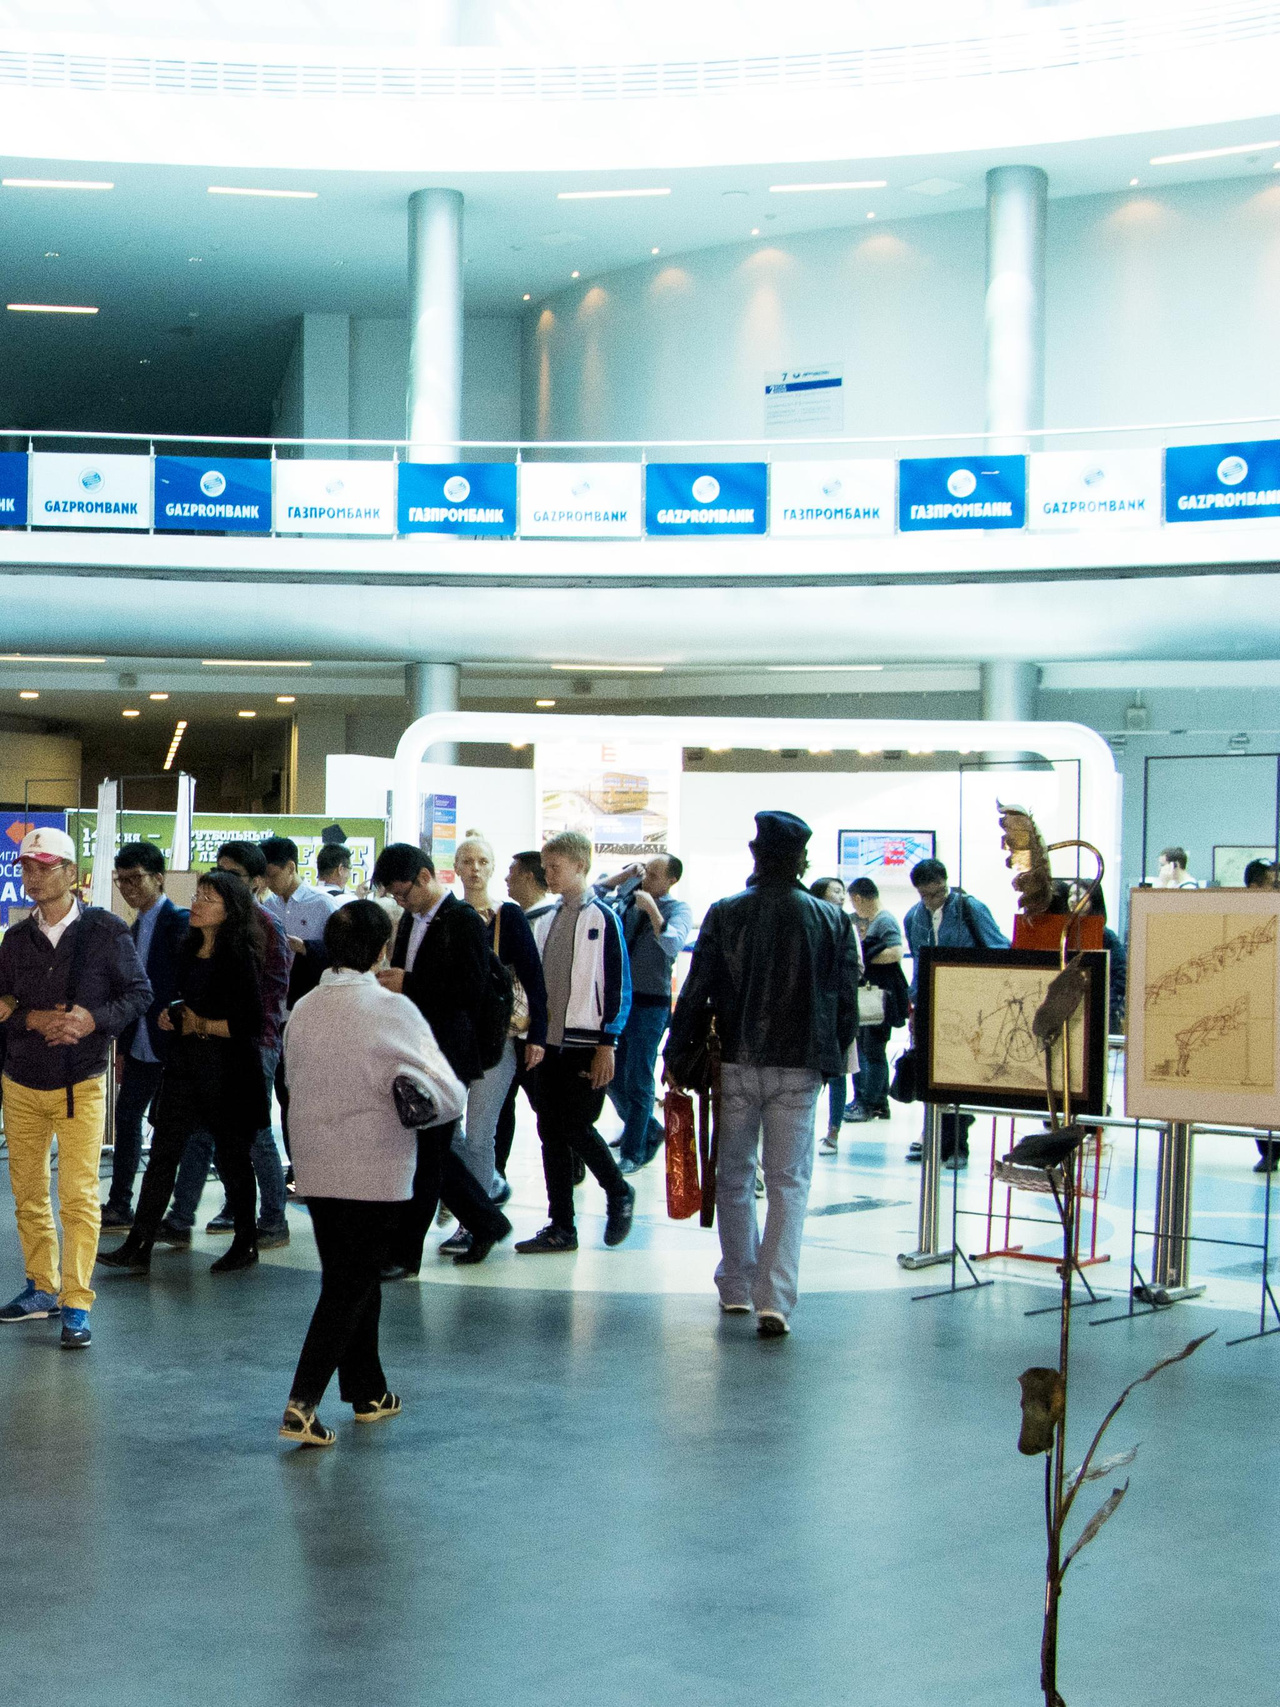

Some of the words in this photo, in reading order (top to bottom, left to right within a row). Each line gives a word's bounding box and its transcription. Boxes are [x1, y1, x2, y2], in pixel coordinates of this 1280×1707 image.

[44, 500, 138, 514] GAZPROMBANK
[165, 503, 259, 519] GAZPROMBANK
[288, 506, 381, 519] ГАЗПРОМБАНК
[783, 507, 881, 520] ГАЗПРОМБАНК
[910, 501, 1013, 519] ГАЗПРОМБАНК
[1043, 499, 1146, 514] GAZPROMBANK
[408, 507, 504, 523] ГАЗПРОМБАНК
[533, 510, 628, 522] GAZPROMBANK
[656, 509, 755, 524] GAZPROMBANK
